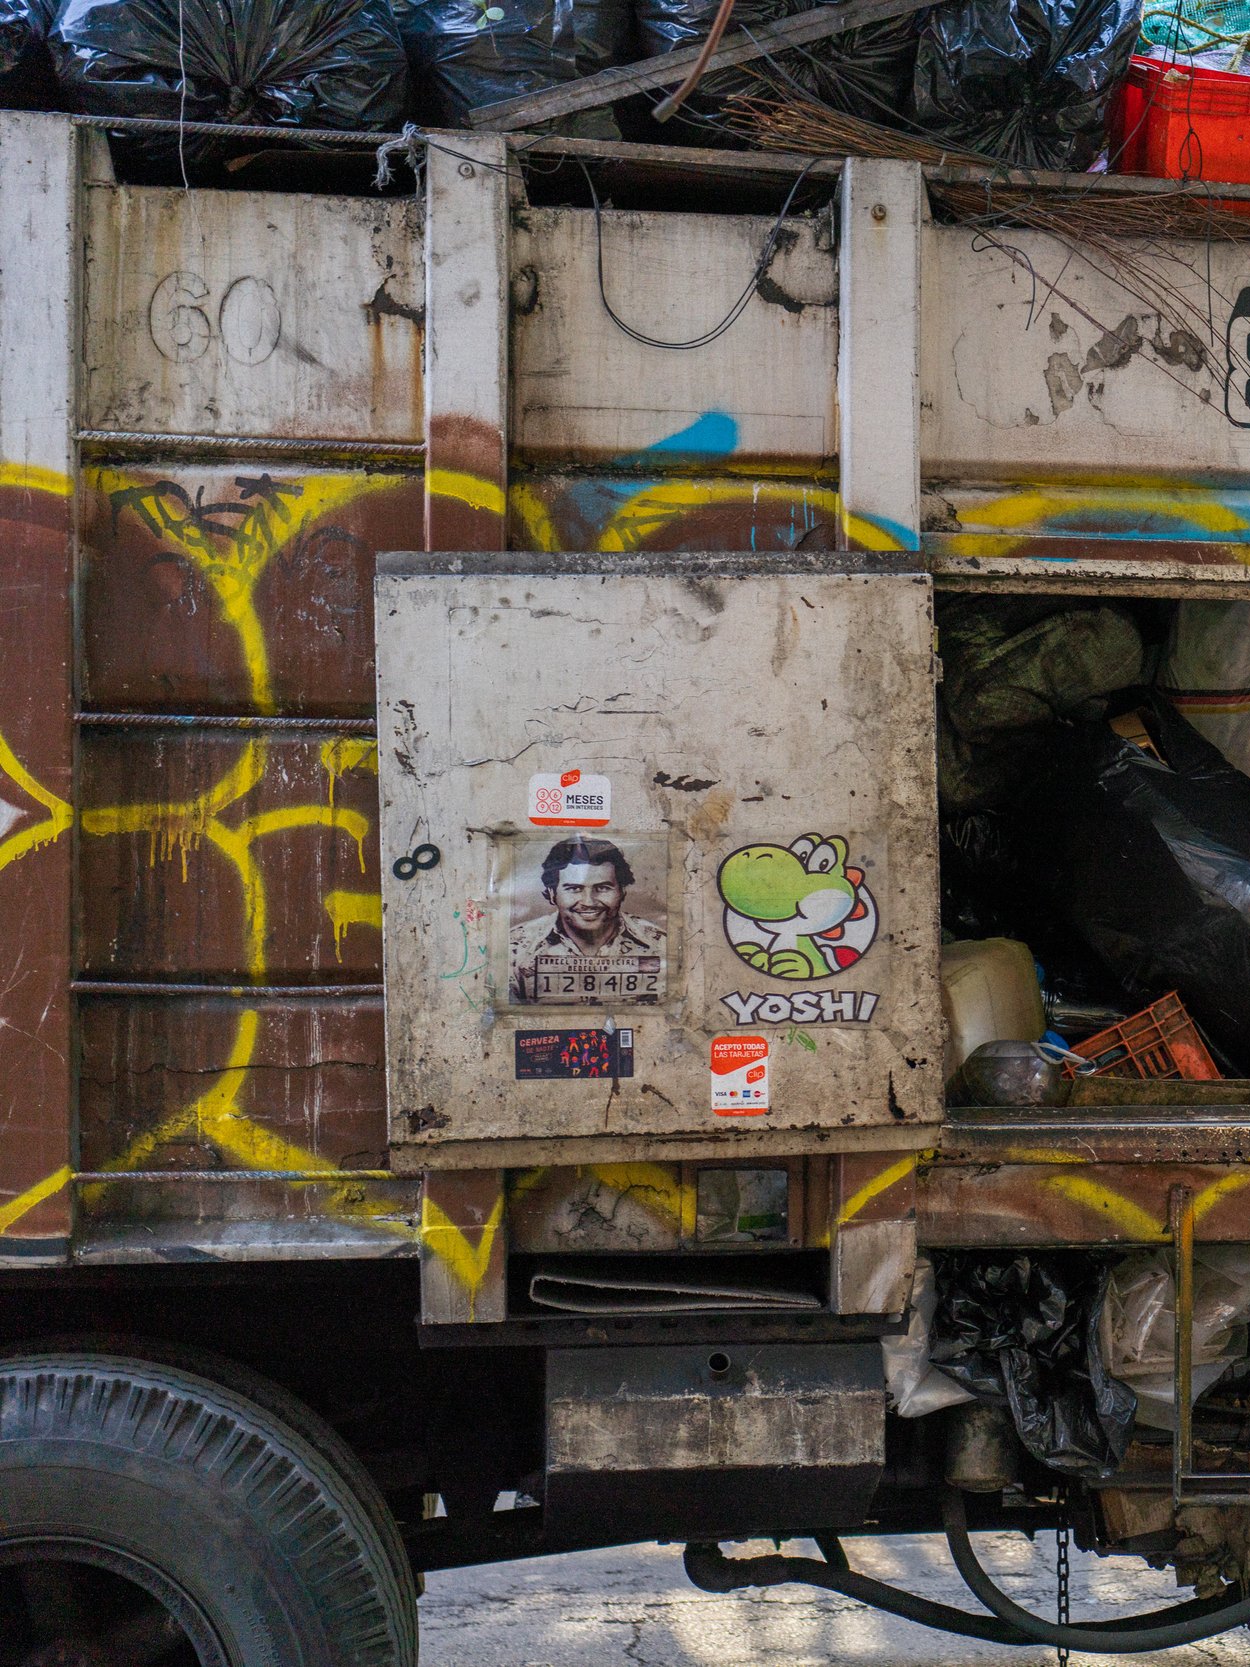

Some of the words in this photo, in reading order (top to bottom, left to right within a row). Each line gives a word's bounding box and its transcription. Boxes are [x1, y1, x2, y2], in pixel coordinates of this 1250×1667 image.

[566, 795, 604, 805] MESES
[597, 958, 635, 966] JUDICIAL
[719, 989, 881, 1026] YOSHI
[519, 1034, 560, 1047] CERVEZA
[714, 1043, 742, 1051] ACEPTO
[714, 1051, 728, 1059] LAS
[729, 1050, 764, 1058] TARJETAS
